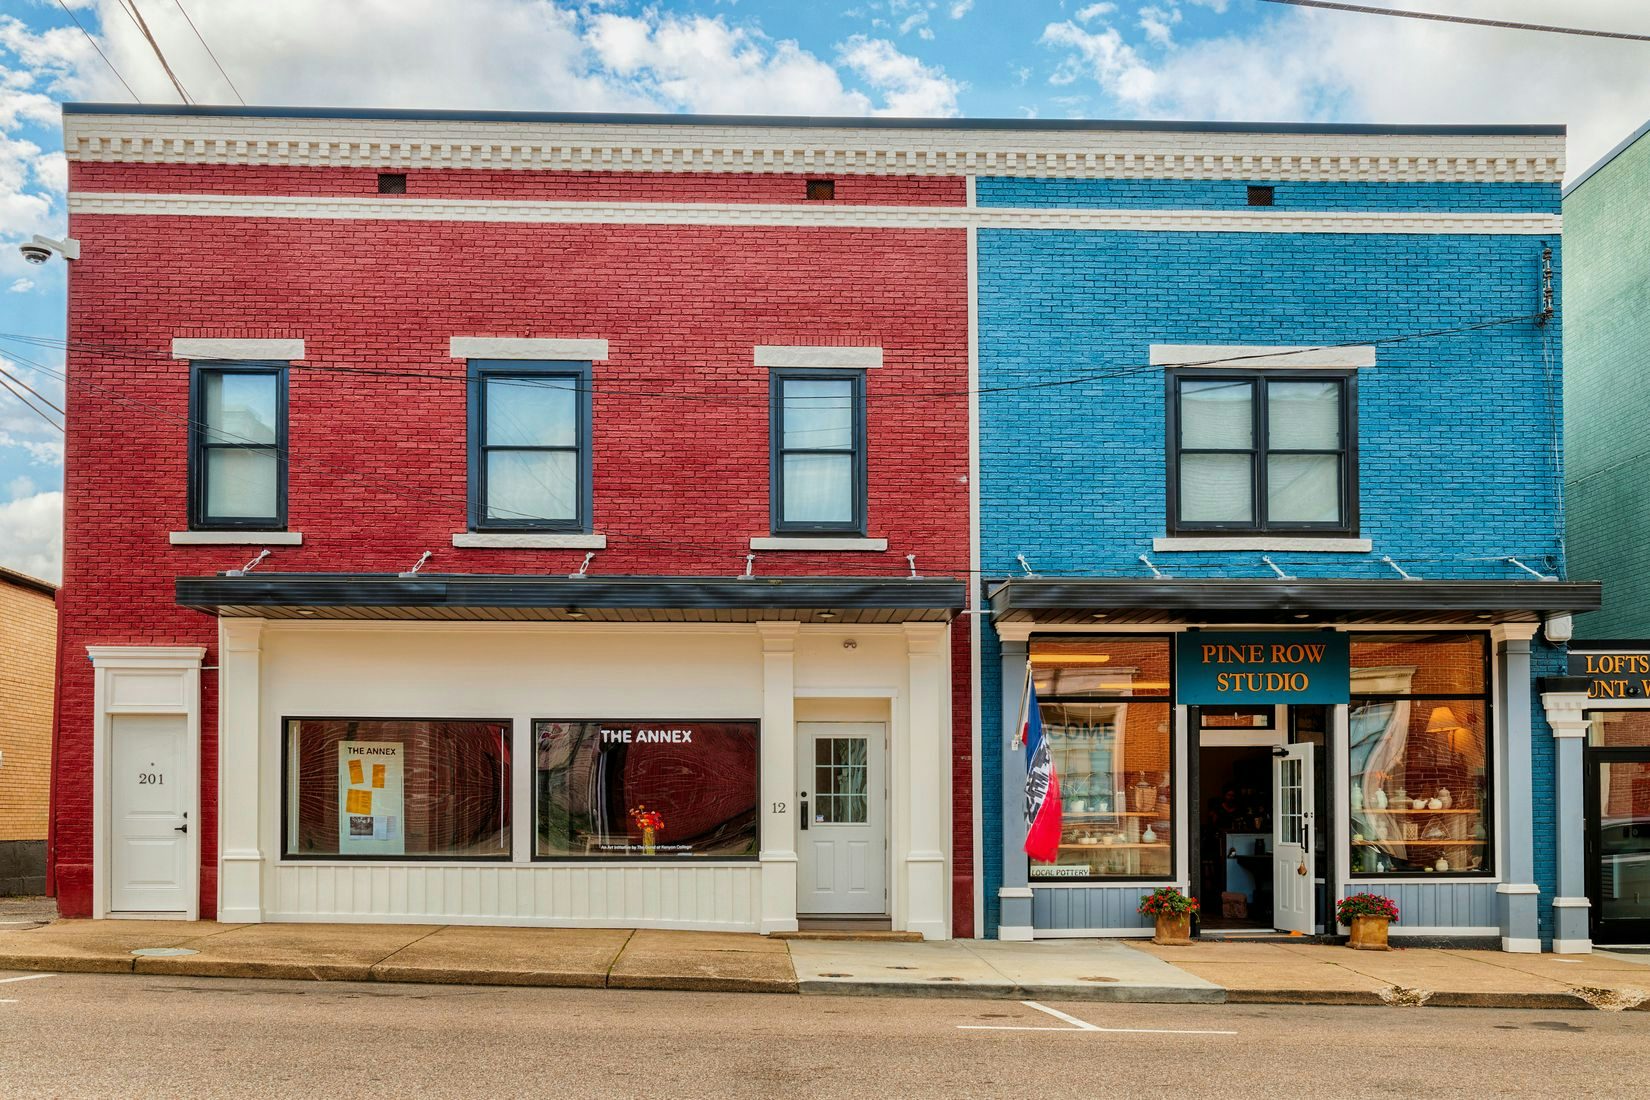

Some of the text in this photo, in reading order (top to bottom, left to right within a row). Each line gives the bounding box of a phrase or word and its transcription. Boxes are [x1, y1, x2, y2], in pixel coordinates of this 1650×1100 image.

[1201, 644, 1327, 664] PINE ROW
[1585, 655, 1650, 673] LOFTS
[1217, 672, 1309, 692] STUDIO
[601, 730, 692, 743] THE ANNEX
[348, 747, 396, 756] THE ANNEX
[139, 773, 163, 785] 201
[772, 802, 786, 813] 12
